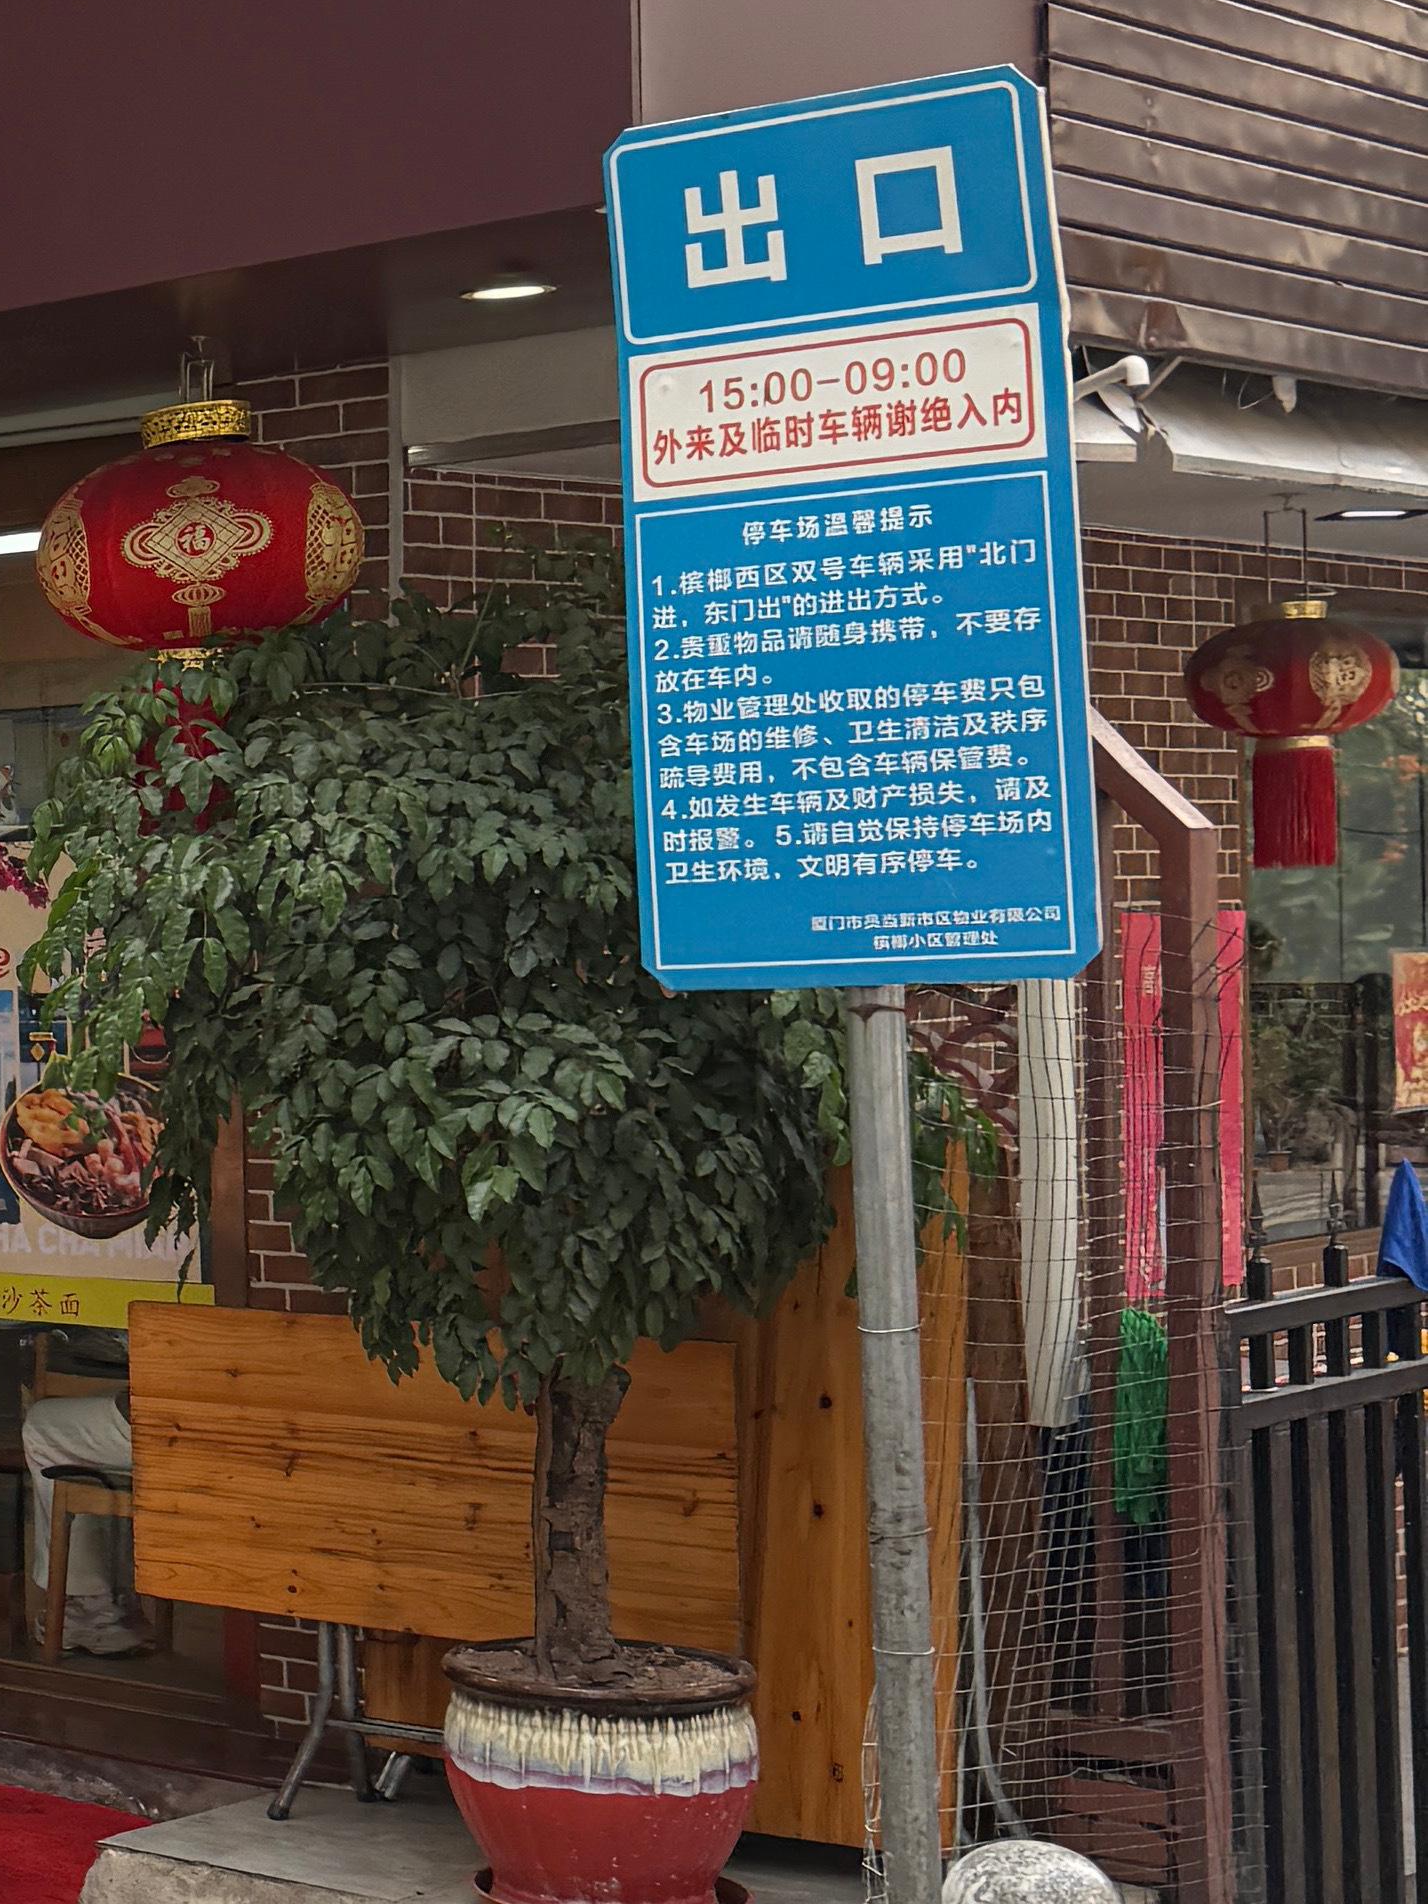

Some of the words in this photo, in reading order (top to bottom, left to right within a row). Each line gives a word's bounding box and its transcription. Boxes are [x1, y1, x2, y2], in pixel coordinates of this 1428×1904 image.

[684, 146, 964, 289] 出口
[699, 347, 967, 413] 15:00-09:00
[652, 388, 1024, 466] 外来及临时车辆谢绝入内
[742, 504, 933, 546] 停车场温馨提示
